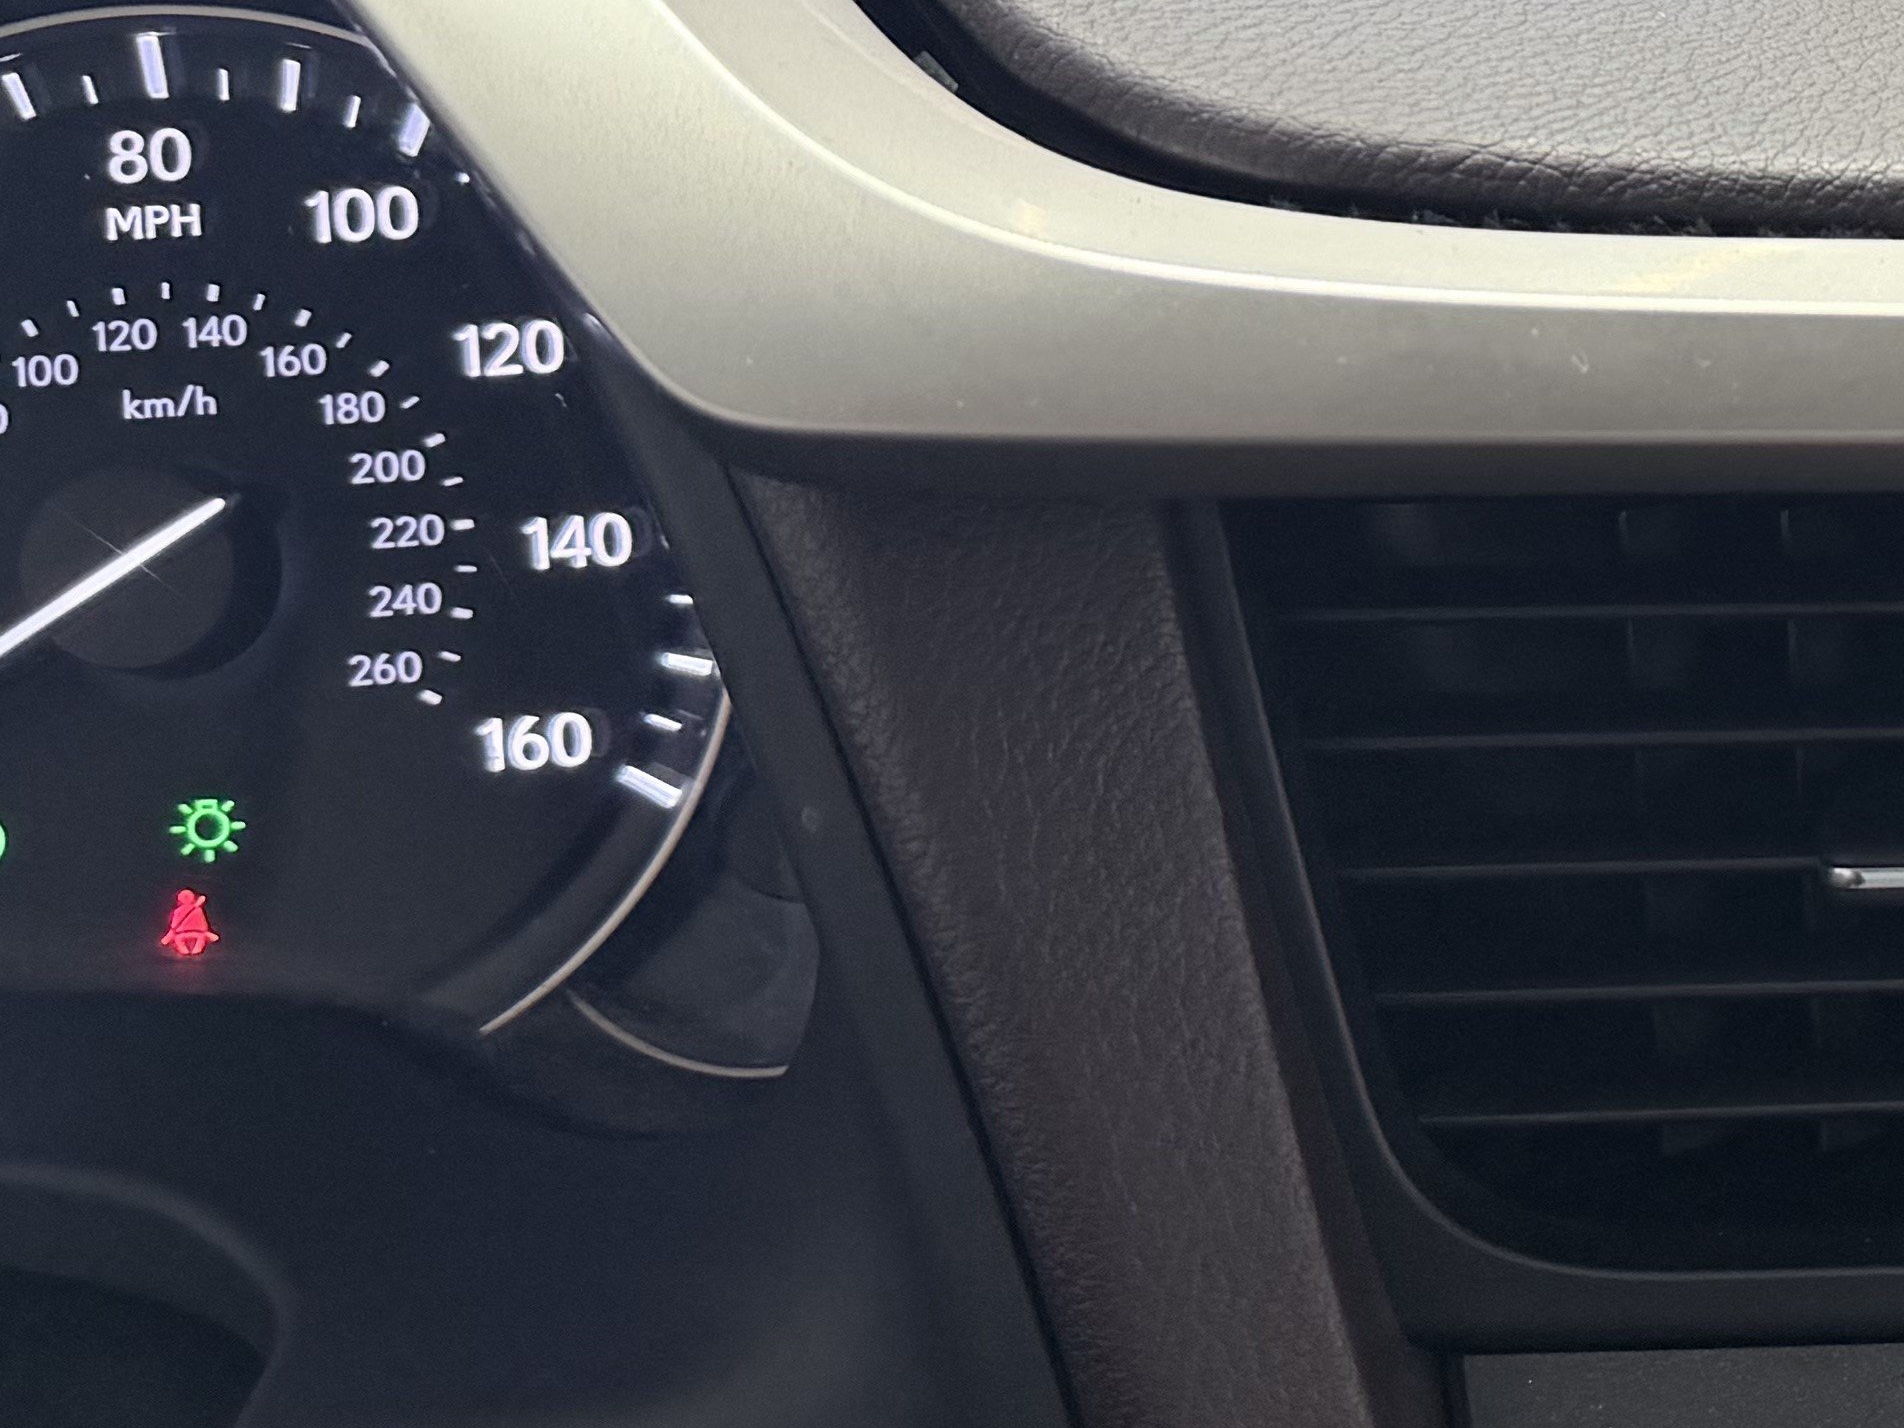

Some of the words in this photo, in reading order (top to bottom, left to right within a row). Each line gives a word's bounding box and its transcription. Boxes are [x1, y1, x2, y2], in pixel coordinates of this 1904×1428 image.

[107, 128, 193, 184] 80
[104, 203, 203, 241] MPH
[305, 185, 420, 245] 100
[91, 317, 158, 352] 120
[182, 313, 248, 349] 140
[452, 318, 566, 379] 120
[12, 353, 80, 388] 100
[260, 344, 328, 378] 160
[121, 384, 218, 420] km/h
[319, 391, 386, 426] 180
[349, 449, 426, 486] 200
[370, 514, 445, 548] 220
[522, 512, 634, 570] 140
[368, 582, 442, 618] 240
[348, 650, 423, 687] 260
[475, 711, 594, 772] 160
